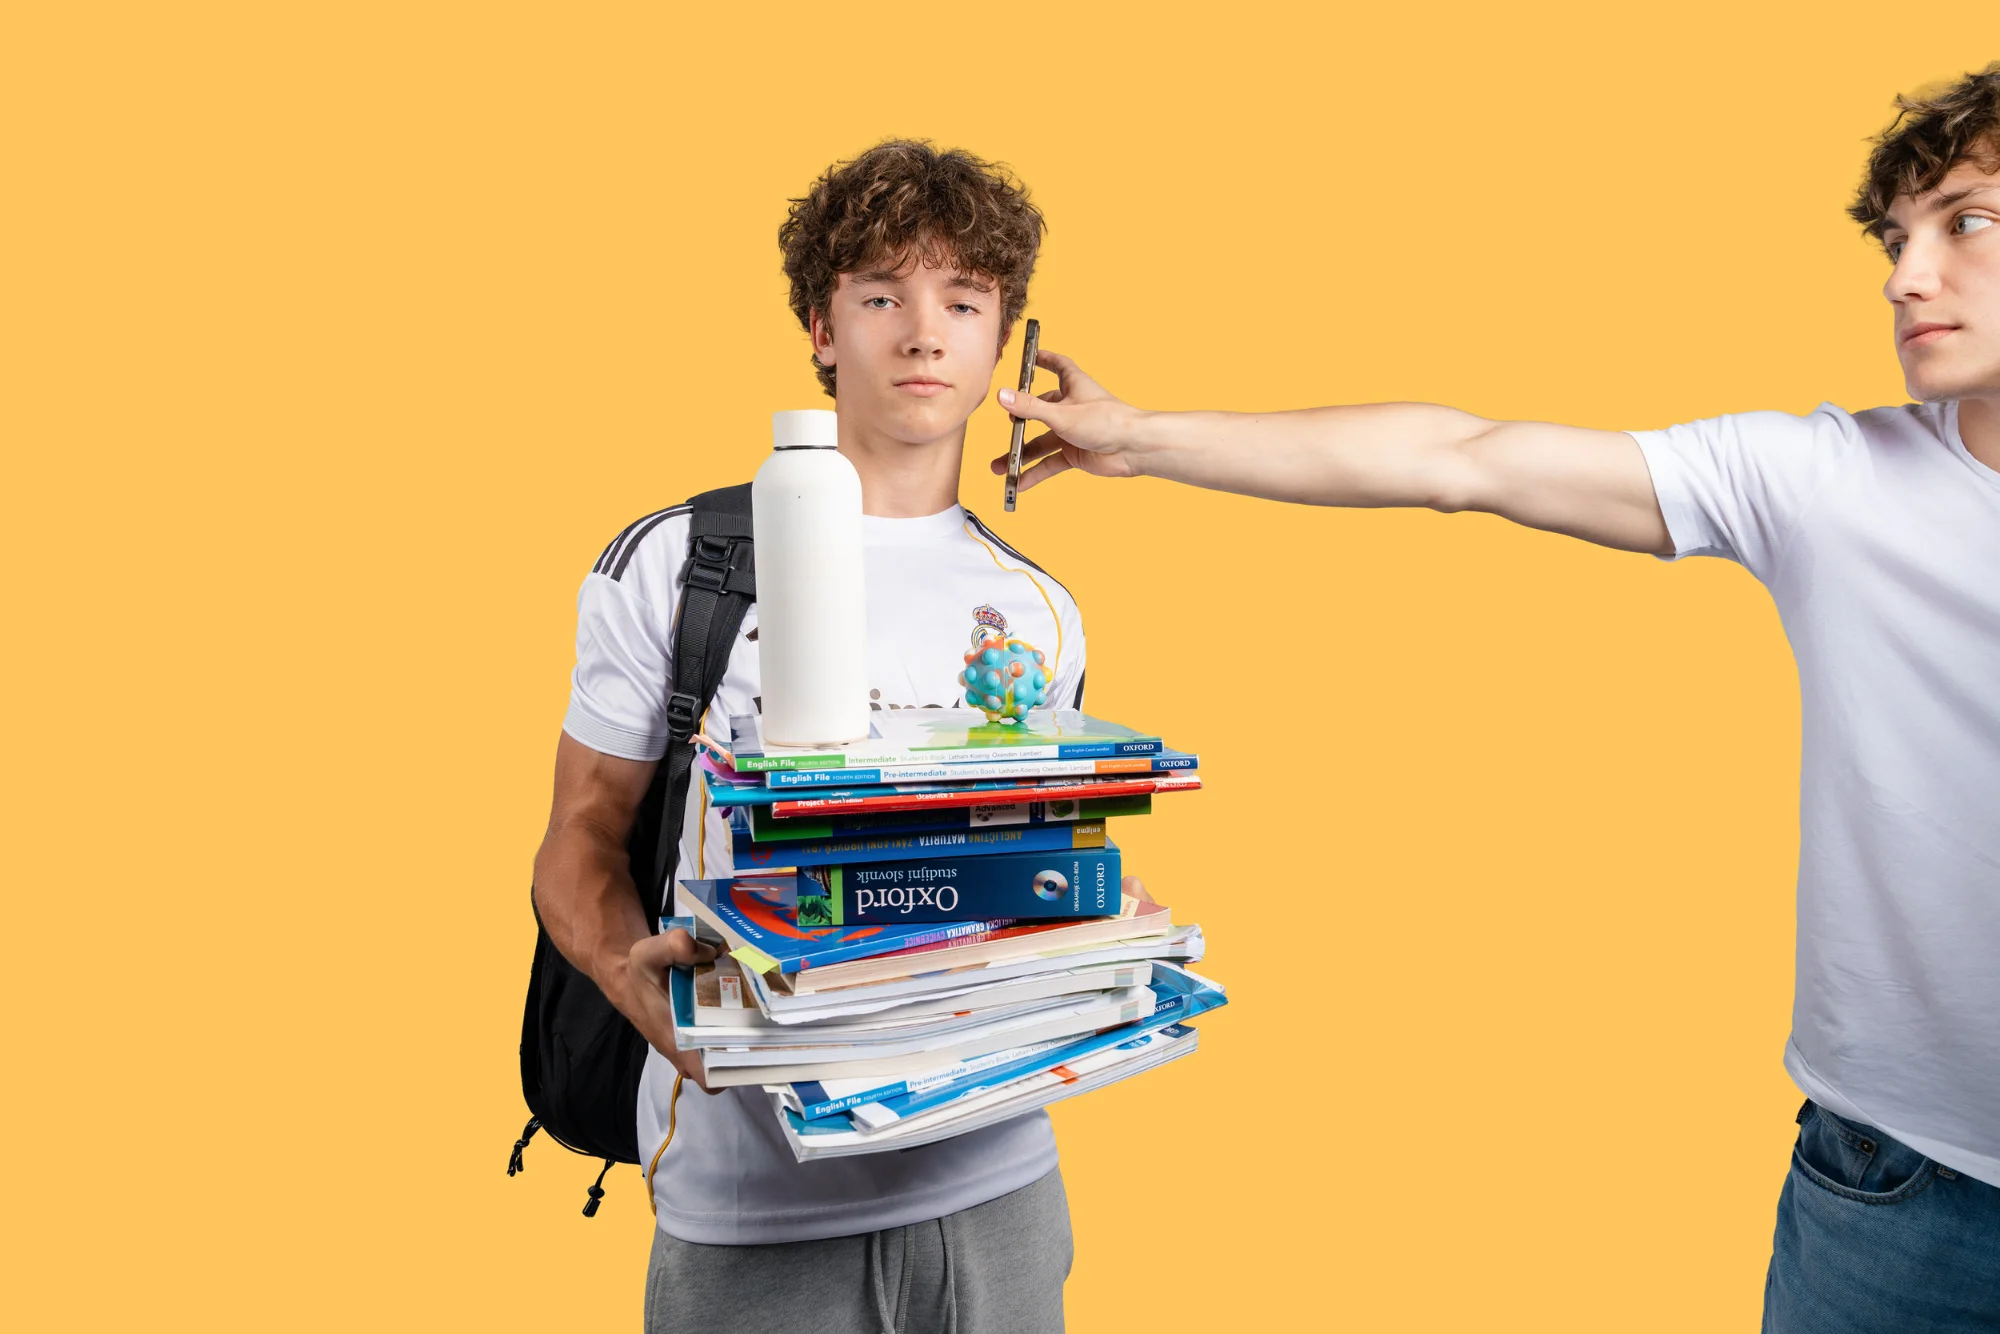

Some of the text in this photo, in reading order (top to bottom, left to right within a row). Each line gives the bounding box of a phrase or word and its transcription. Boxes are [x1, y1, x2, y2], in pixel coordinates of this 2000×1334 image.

[1123, 743, 1154, 751] OXFORD
[747, 760, 777, 771] English
[780, 759, 796, 768] File
[849, 755, 896, 764] Intermediate
[900, 754, 928, 762] Student's
[929, 753, 946, 761] Book
[949, 752, 990, 761] Latham-Koenig
[1159, 759, 1190, 768] OXFORD
[781, 774, 811, 784] English
[815, 773, 830, 781] File
[884, 770, 947, 778] Pre-intermediate
[950, 767, 980, 775] Student's
[999, 766, 1040, 775] Latham-Koenig
[1047, 784, 1086, 792] Hutchinson
[975, 802, 1016, 812] Advanced
[1076, 826, 1101, 835] enigma
[919, 833, 966, 847] MATURITA
[856, 868, 957, 884] studijní slovník
[1096, 862, 1105, 909] OXFORD
[855, 885, 959, 915] Oxford
[946, 921, 985, 938] GRAMATIKA
[1153, 1000, 1176, 1013] XFORD
[815, 1101, 845, 1115] English
[846, 1096, 862, 1106] File
[863, 1092, 884, 1101] FOURTH
[884, 1087, 903, 1096] EDITION
[909, 1067, 967, 1089] Pre-intermediate
[996, 1055, 1010, 1065] Book
